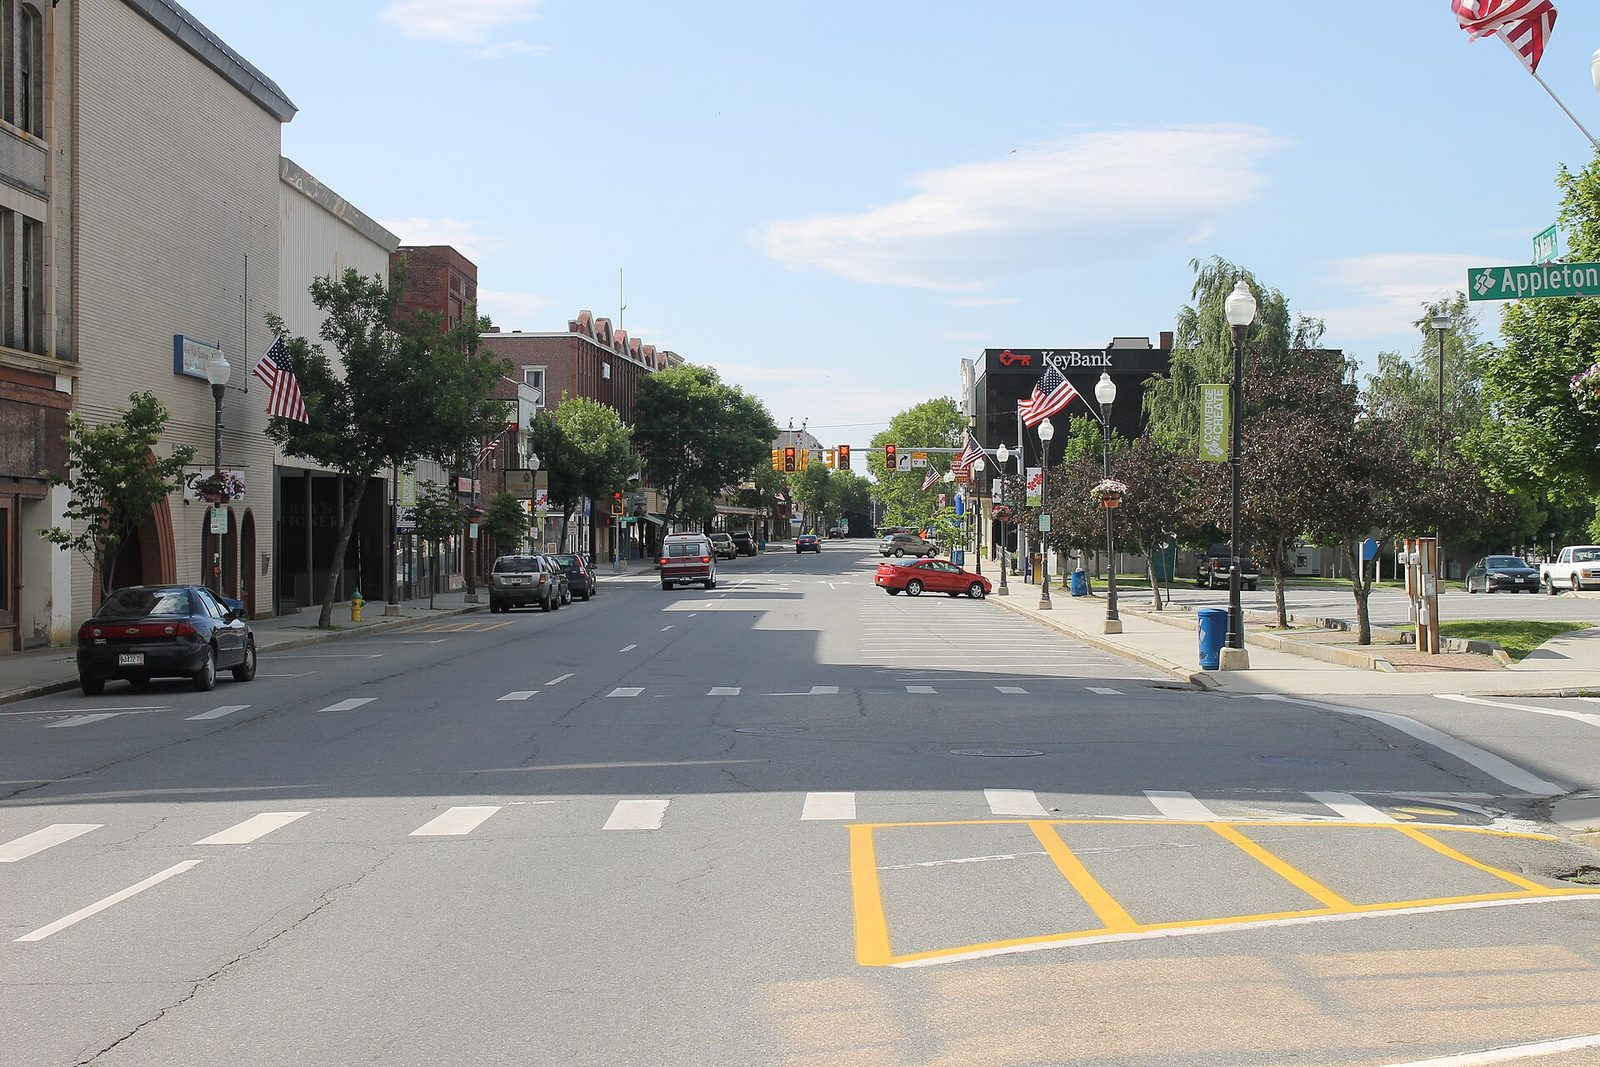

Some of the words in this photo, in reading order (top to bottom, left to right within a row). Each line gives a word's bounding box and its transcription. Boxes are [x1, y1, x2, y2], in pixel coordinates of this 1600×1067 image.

[1501, 265, 1597, 297] Appleton
[1041, 351, 1112, 370] KeyBank
[1204, 388, 1213, 442] CONVERGE
